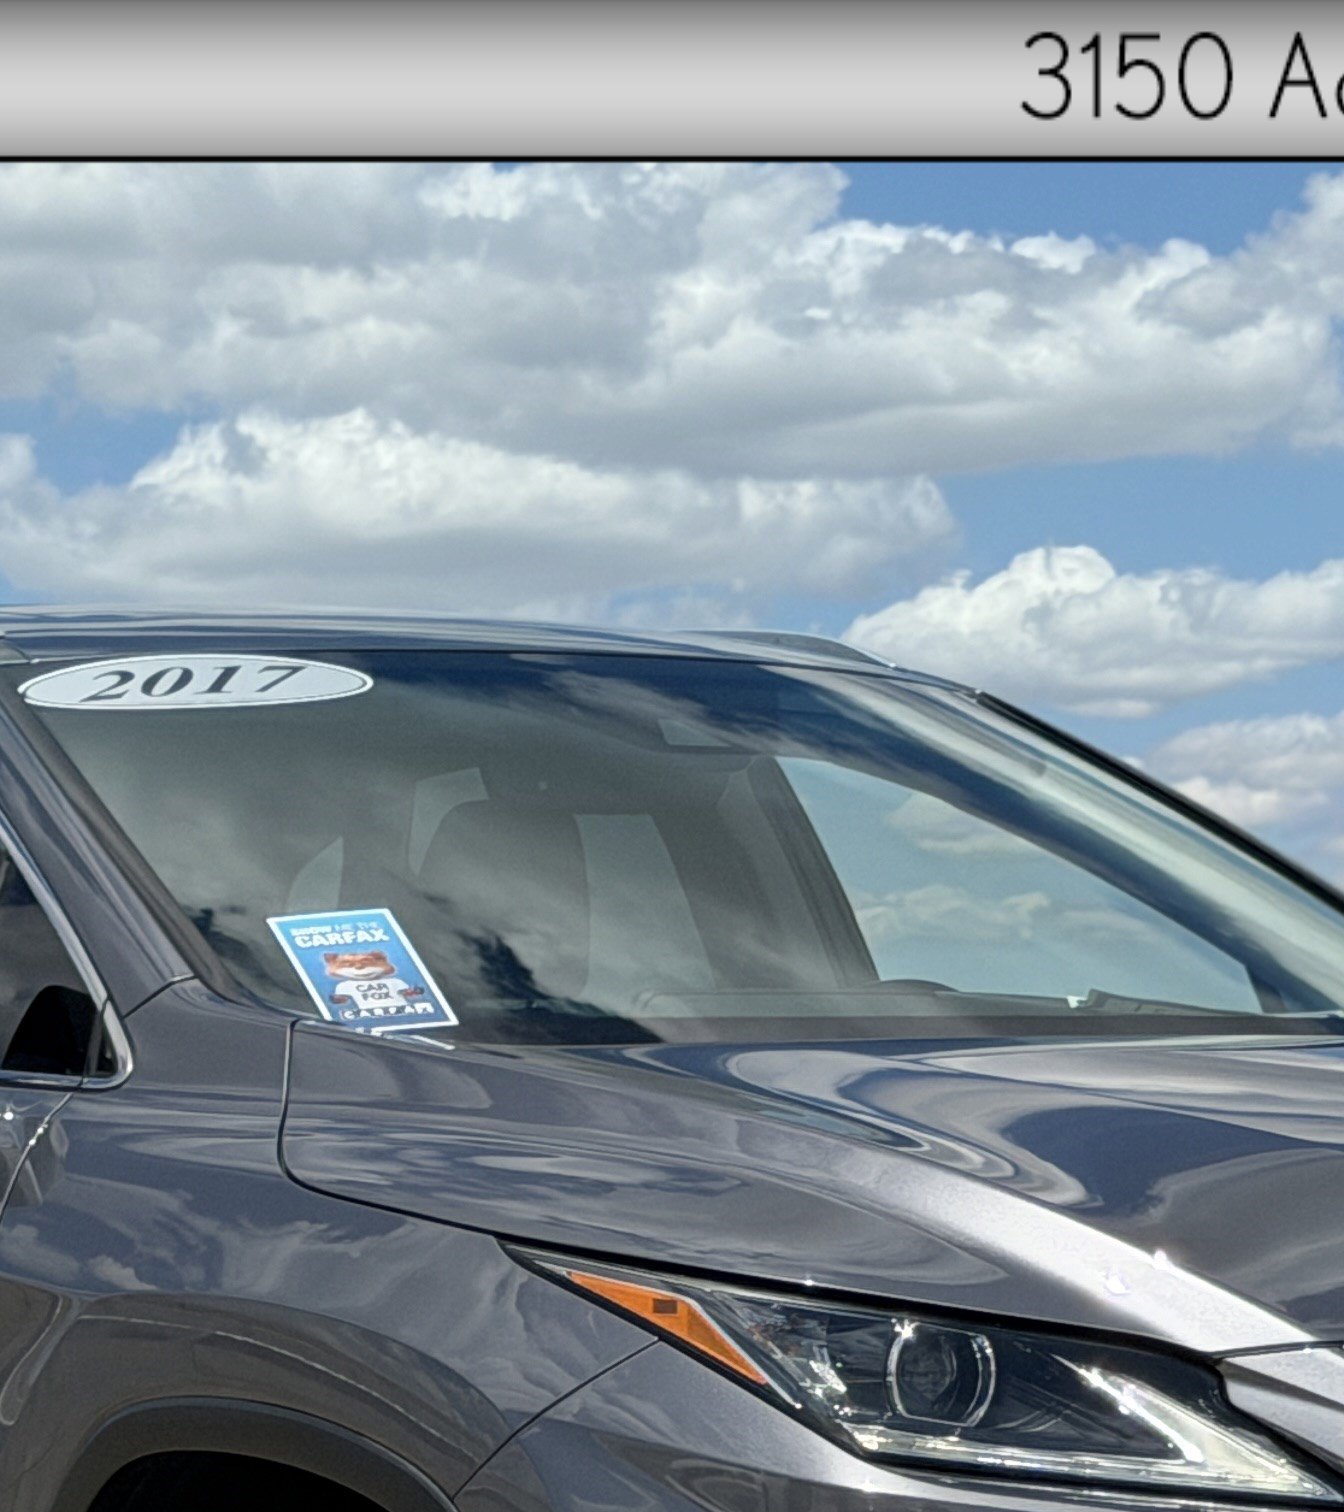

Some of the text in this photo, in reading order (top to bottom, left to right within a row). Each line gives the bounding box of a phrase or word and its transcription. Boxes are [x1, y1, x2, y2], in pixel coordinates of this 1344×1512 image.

[80, 664, 309, 703] 2017
[295, 927, 390, 948] CARFAX
[355, 982, 390, 994] CAR
[361, 991, 394, 1002] FOX
